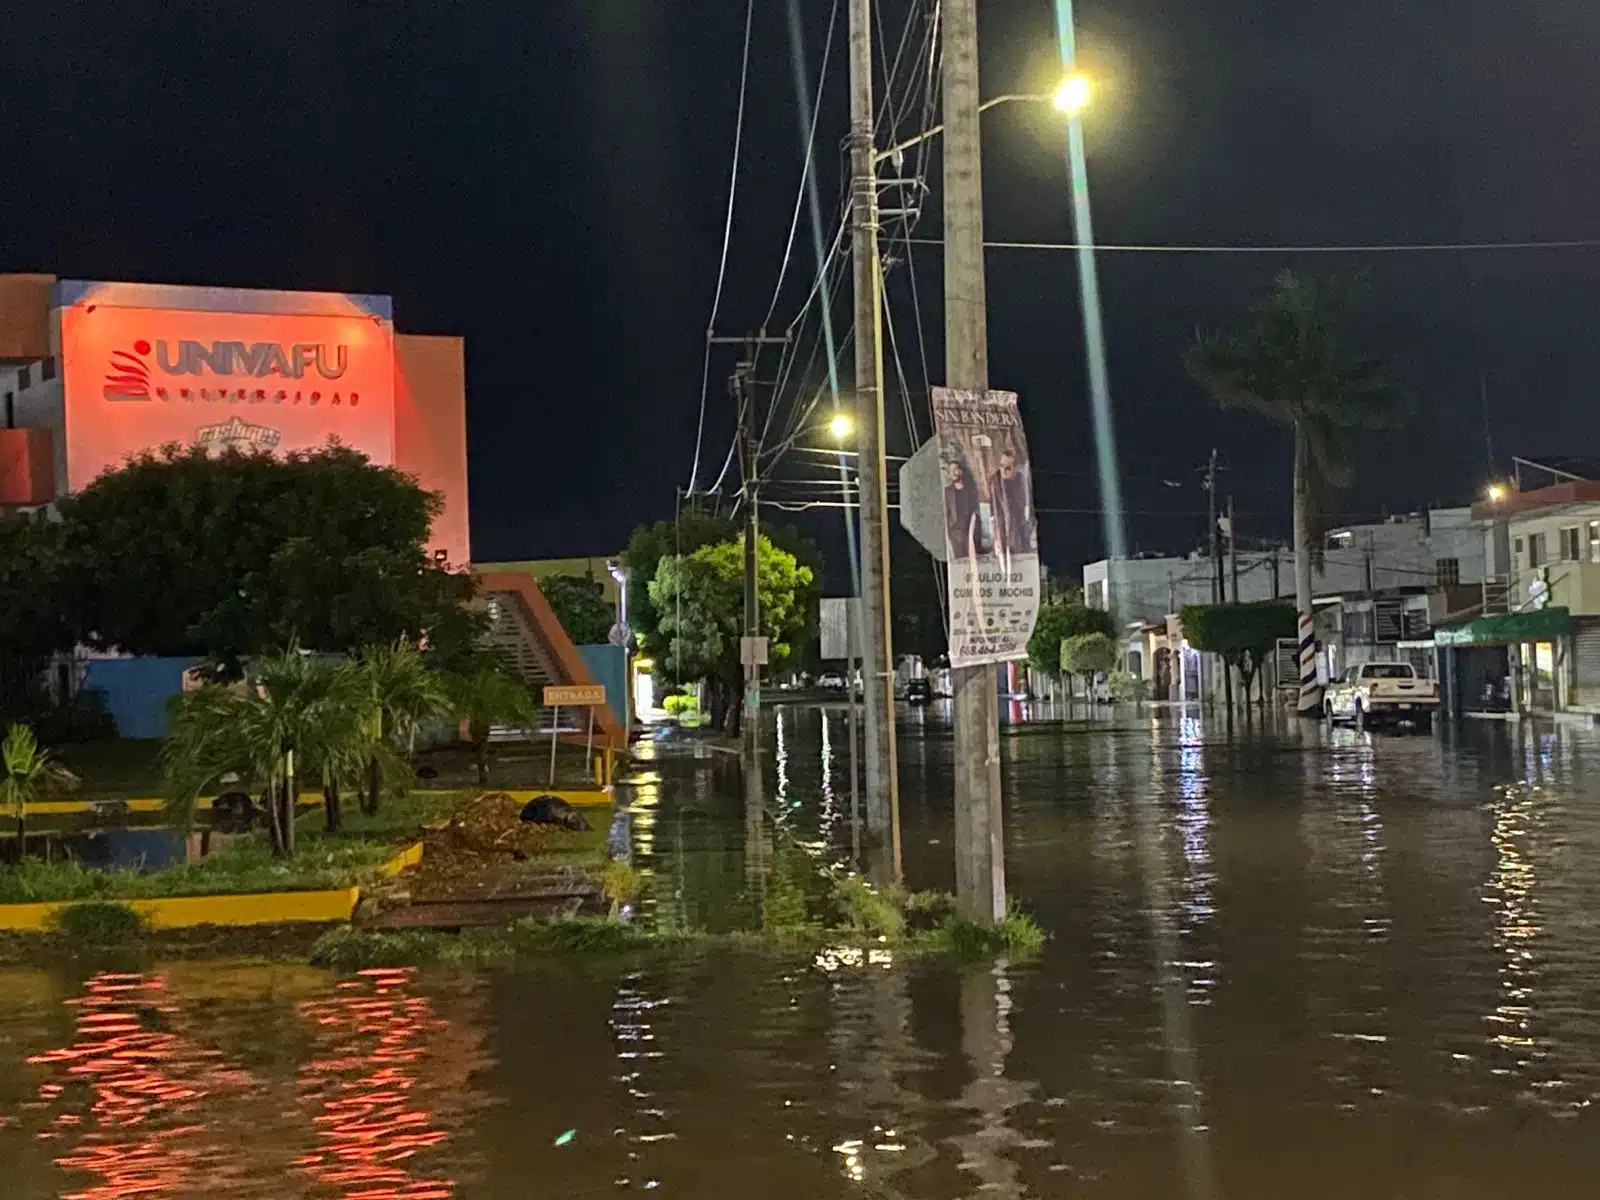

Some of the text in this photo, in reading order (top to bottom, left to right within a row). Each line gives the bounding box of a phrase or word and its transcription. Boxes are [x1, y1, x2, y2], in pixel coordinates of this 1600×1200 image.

[155, 338, 348, 380] UNIVAFU
[936, 408, 1019, 426] SIN BANDERA
[976, 572, 1002, 583] ULIO
[975, 587, 993, 599] OS
[999, 587, 1034, 598] MOCHIS
[547, 691, 601, 701] ENTRADA
